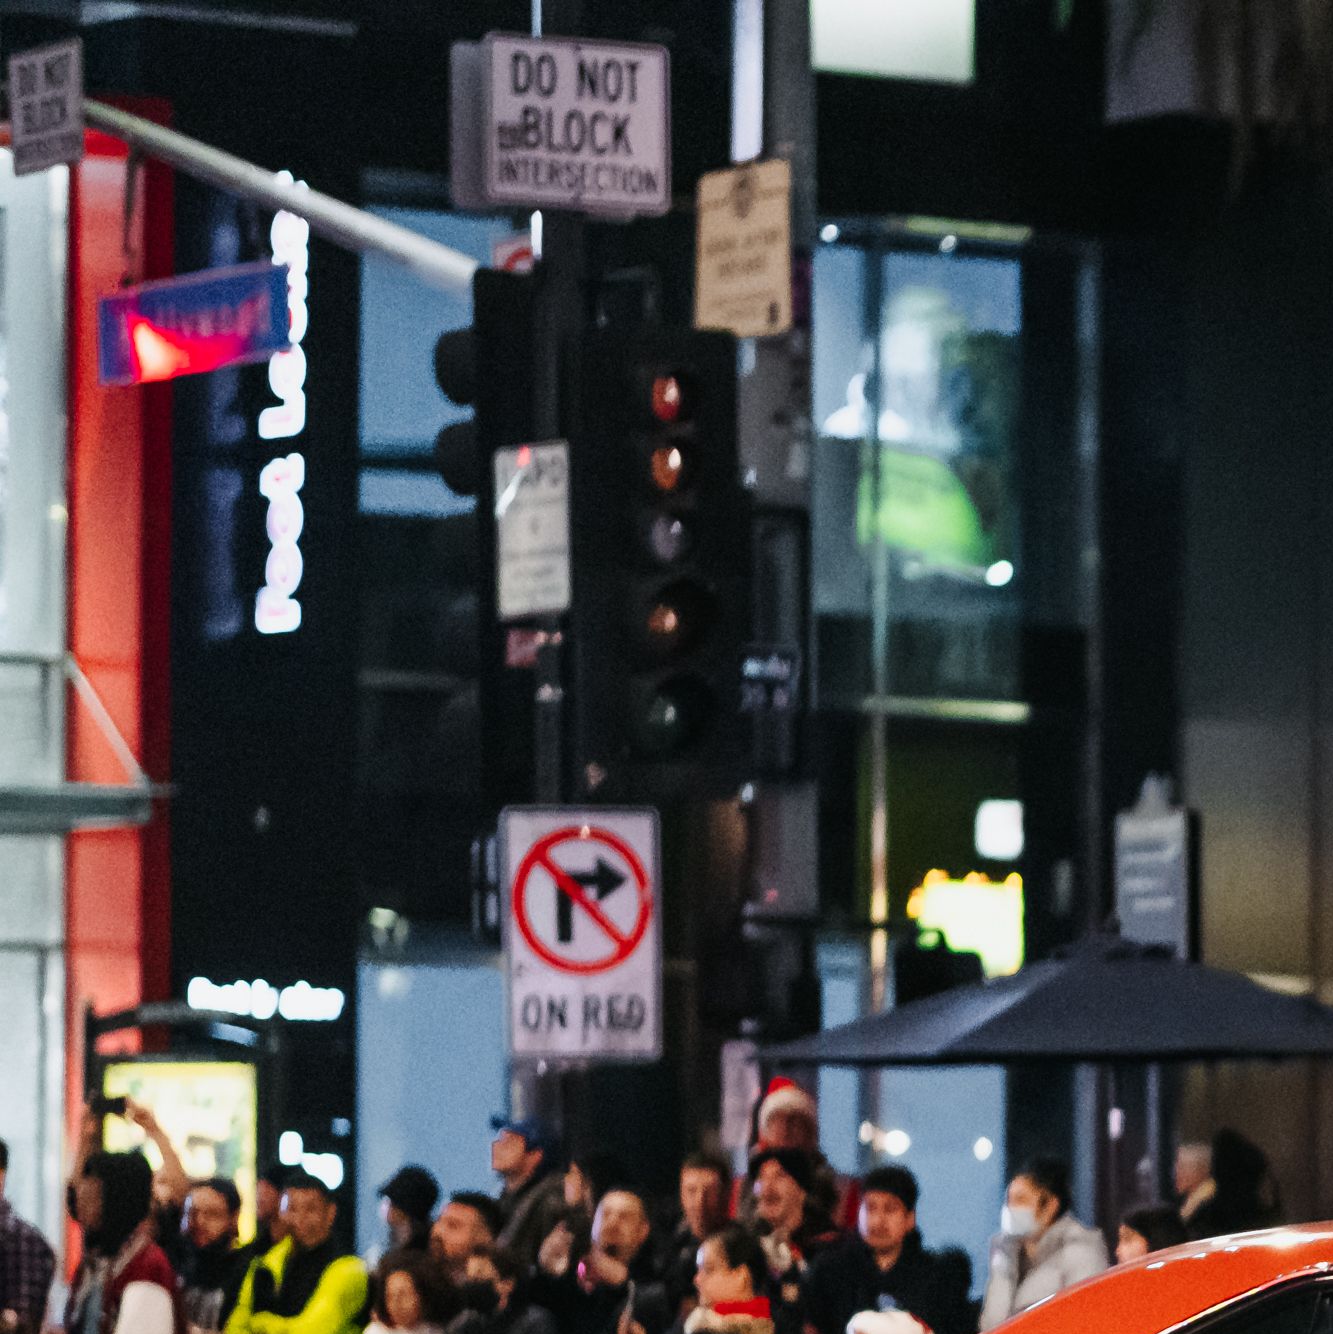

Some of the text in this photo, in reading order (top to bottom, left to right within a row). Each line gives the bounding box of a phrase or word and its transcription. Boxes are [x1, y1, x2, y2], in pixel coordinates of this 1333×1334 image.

[510, 53, 640, 104] DO NOT
[523, 106, 632, 155] BLOCK
[498, 156, 658, 194] INTERSECTION
[521, 993, 646, 1036] ON RED
